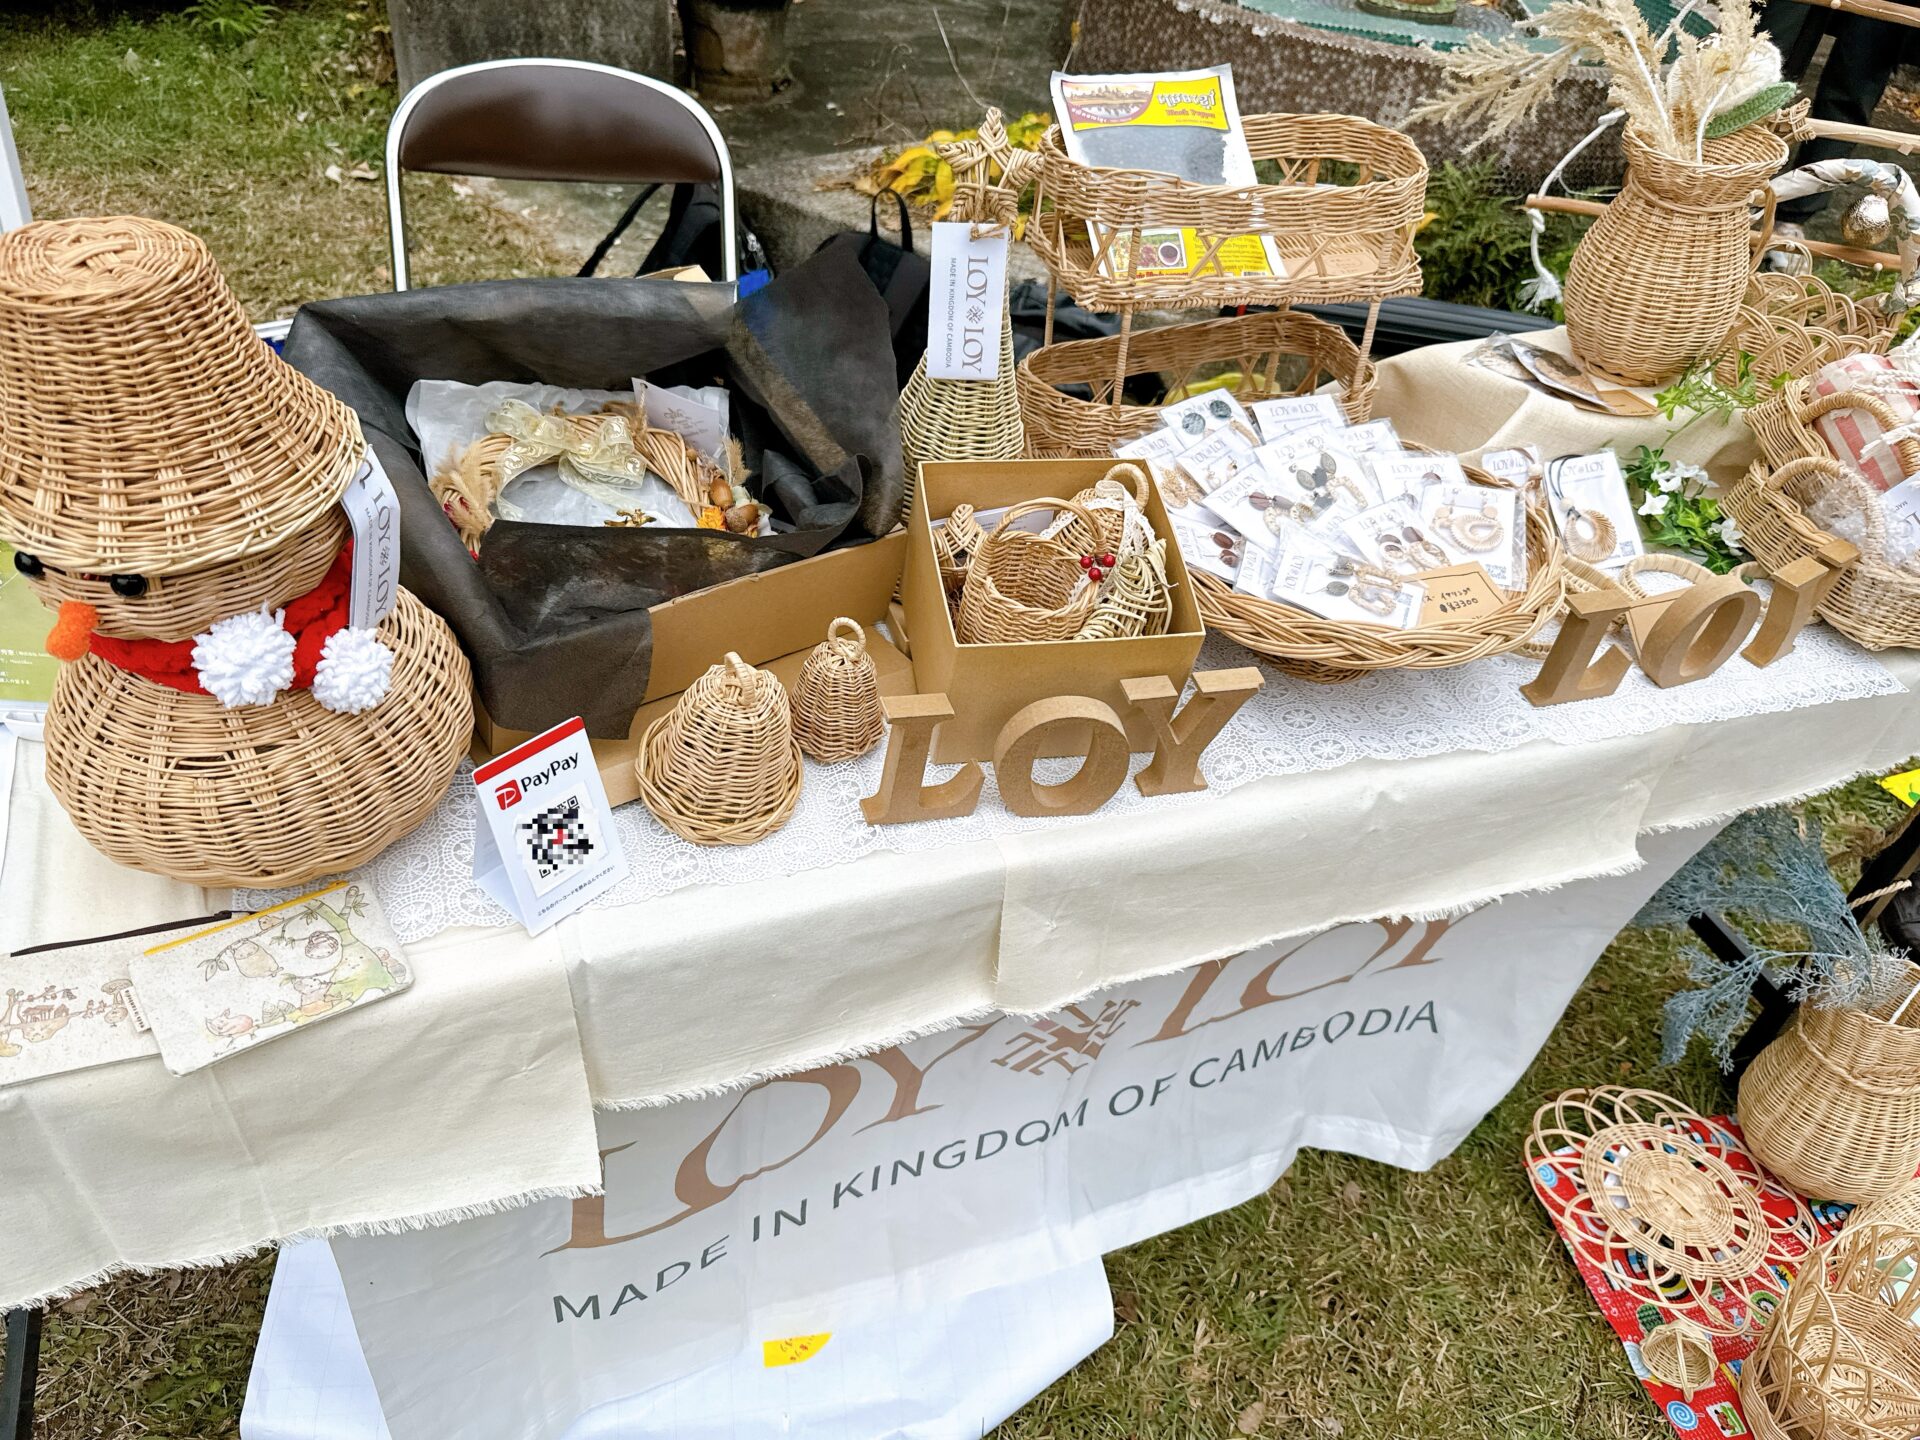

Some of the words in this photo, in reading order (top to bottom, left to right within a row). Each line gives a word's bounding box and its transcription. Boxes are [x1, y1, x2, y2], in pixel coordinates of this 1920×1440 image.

[947, 288, 955, 322] KINGDOM
[949, 279, 955, 287] IN
[965, 256, 989, 307] LOY
[944, 334, 953, 369] CAMBODIA
[946, 323, 953, 332] OF
[961, 326, 985, 375] LOY
[371, 488, 391, 547] LOY
[373, 567, 391, 618] LOY
[859, 666, 1265, 827] LOY
[520, 752, 580, 793] PayPay
[553, 1234, 729, 1323] MADE
[752, 1198, 809, 1243] IN
[832, 1098, 1090, 1210] KINGDOM
[1108, 1072, 1178, 1117] OF
[1188, 1000, 1440, 1089] CAMBODIA
